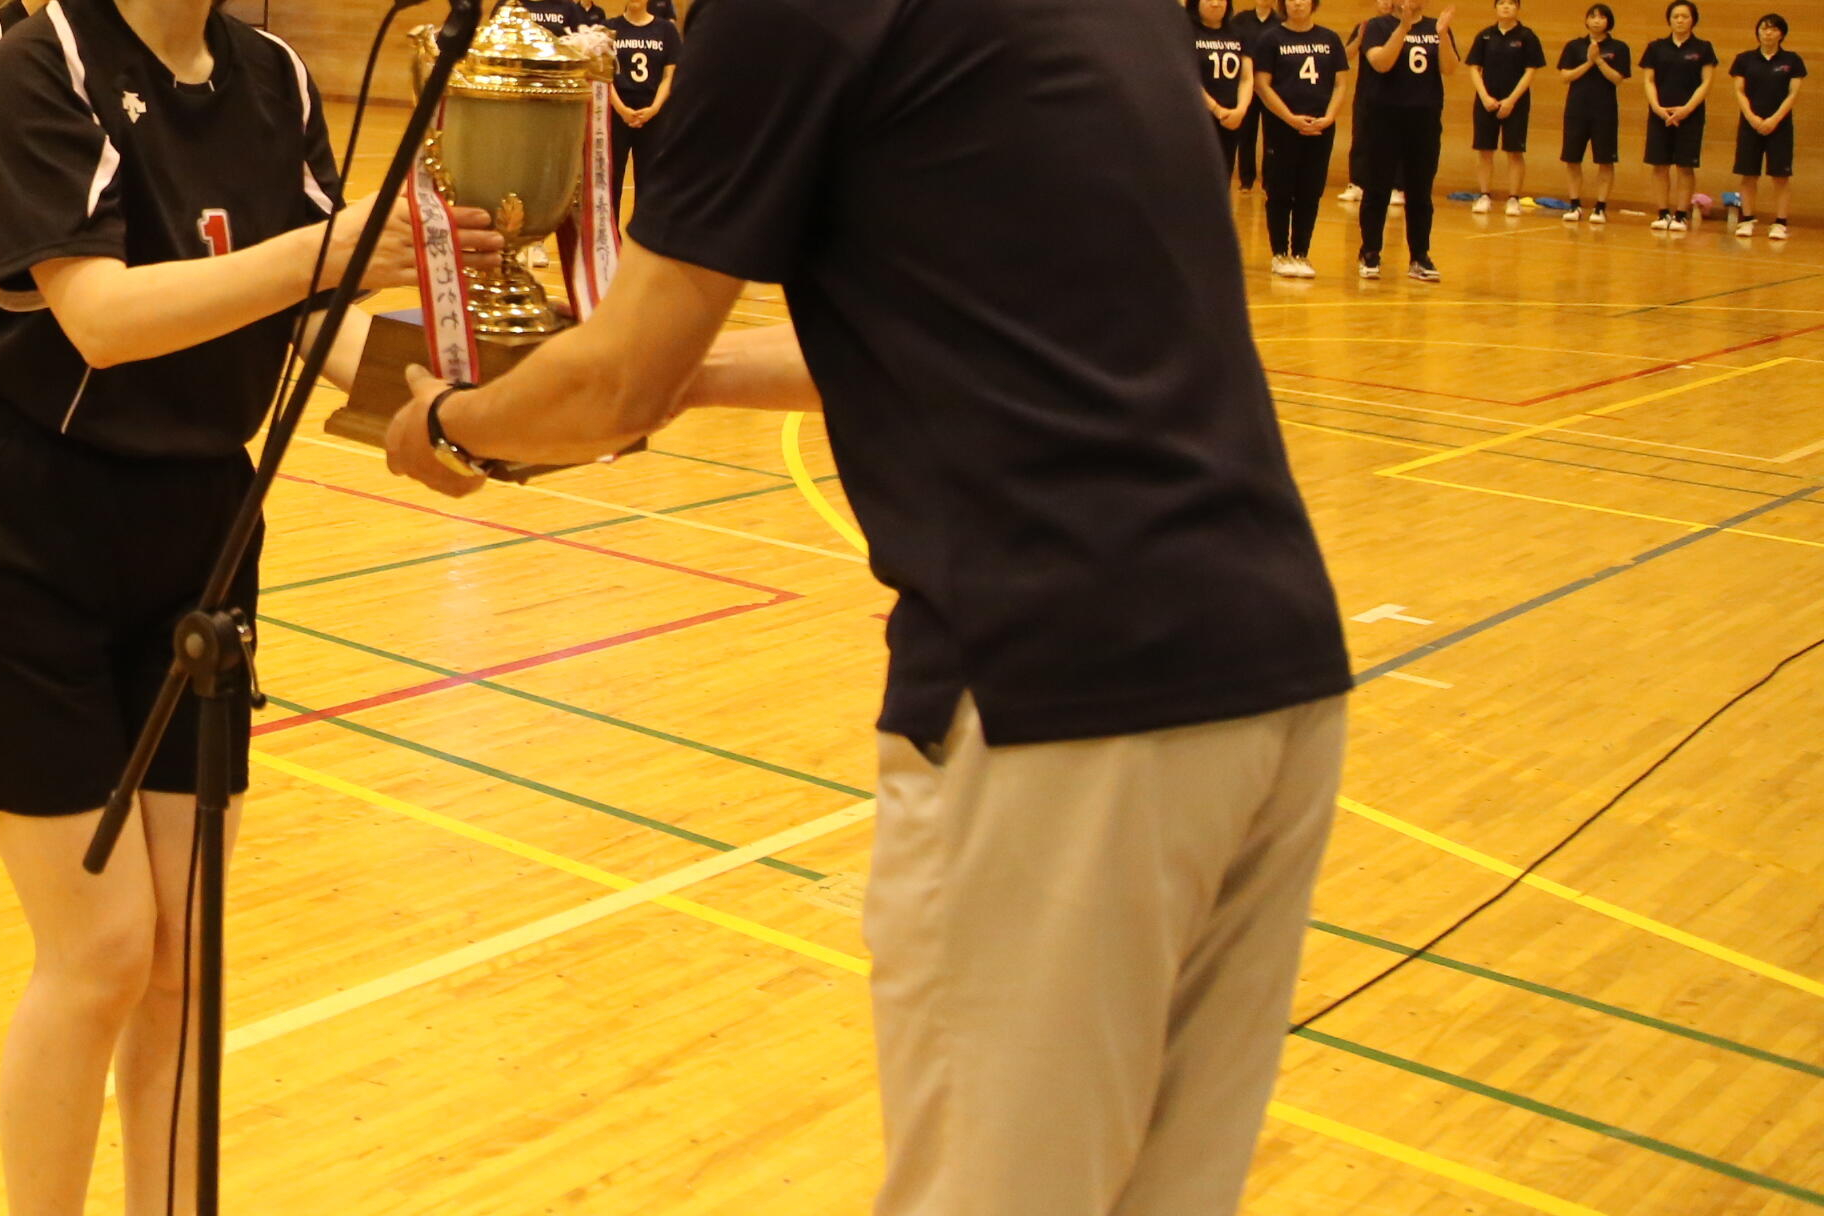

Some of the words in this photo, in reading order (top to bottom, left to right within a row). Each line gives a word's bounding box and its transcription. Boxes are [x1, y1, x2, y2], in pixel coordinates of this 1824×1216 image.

[631, 52, 650, 83] 3
[1208, 51, 1241, 80] 10
[1299, 55, 1320, 85] 4
[1409, 45, 1428, 74] 6
[197, 208, 232, 256] 1
